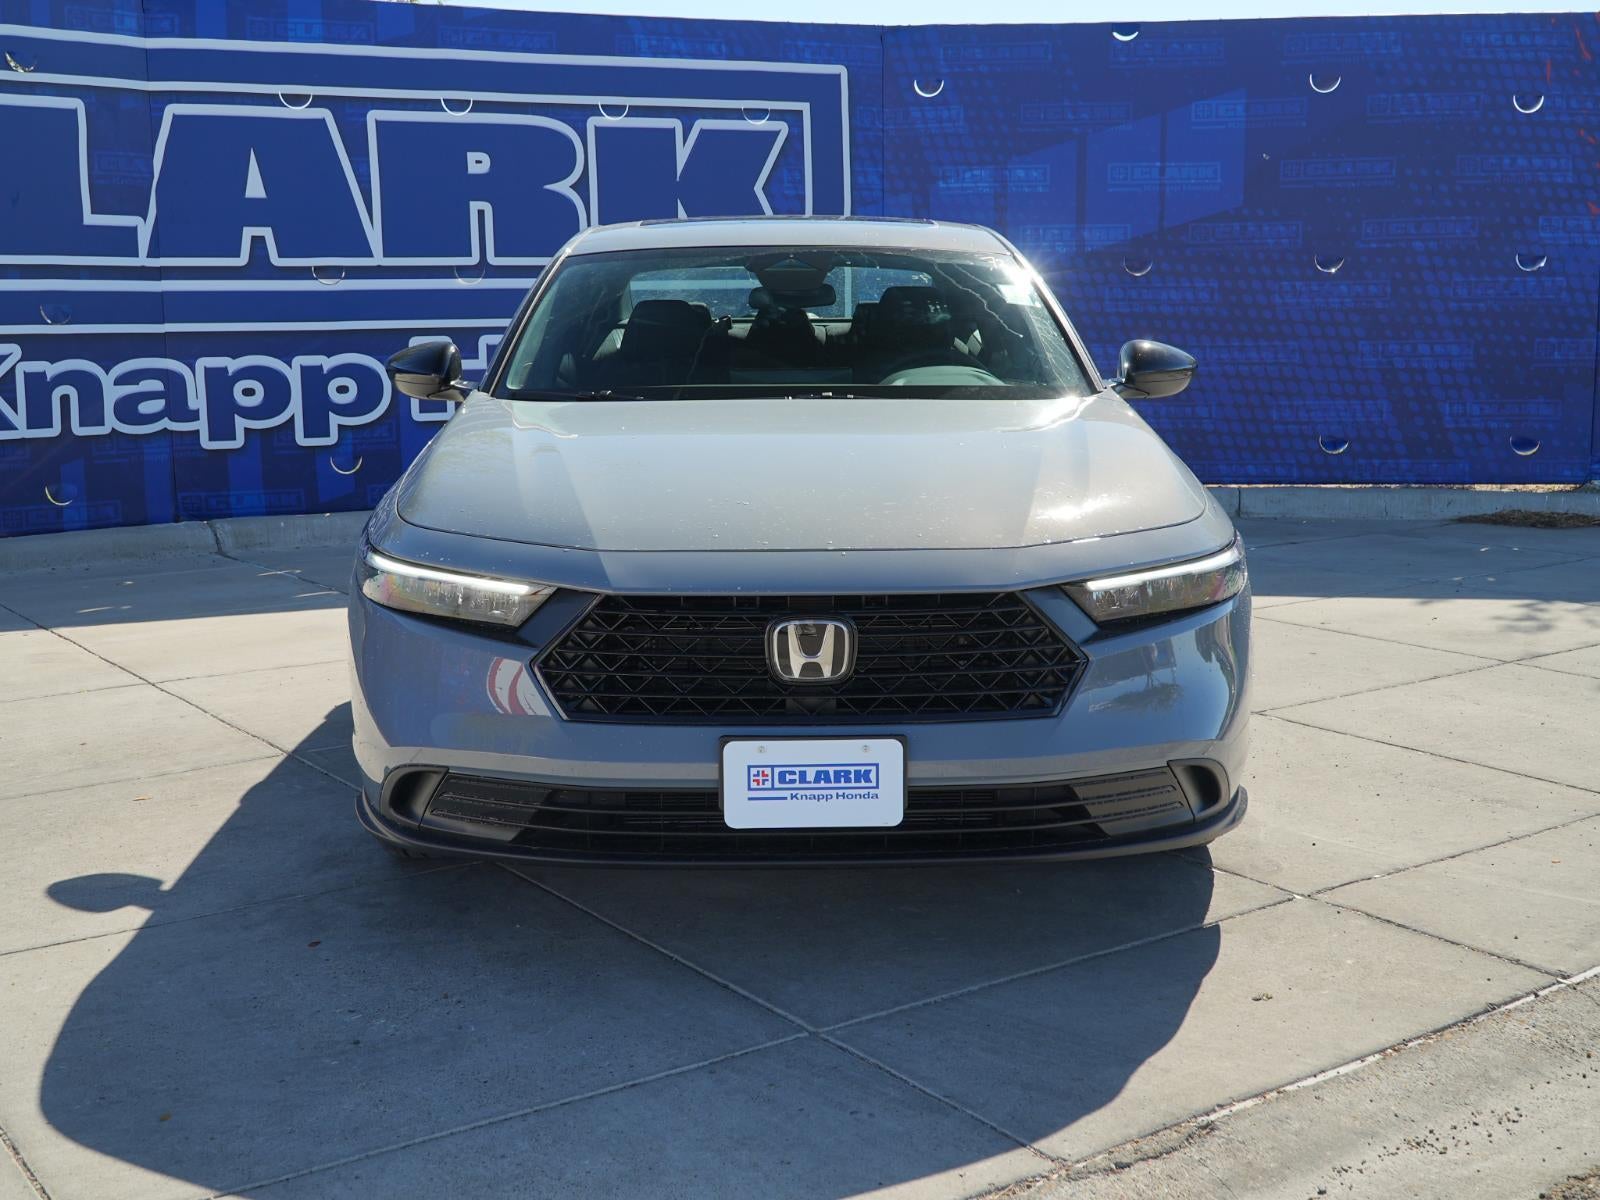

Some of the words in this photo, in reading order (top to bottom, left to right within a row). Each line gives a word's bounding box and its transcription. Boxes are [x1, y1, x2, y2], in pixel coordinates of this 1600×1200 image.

[0, 343, 394, 449] napp
[778, 769, 873, 784] CLARK
[790, 792, 833, 802] Knapp
[835, 791, 879, 800] Honda
